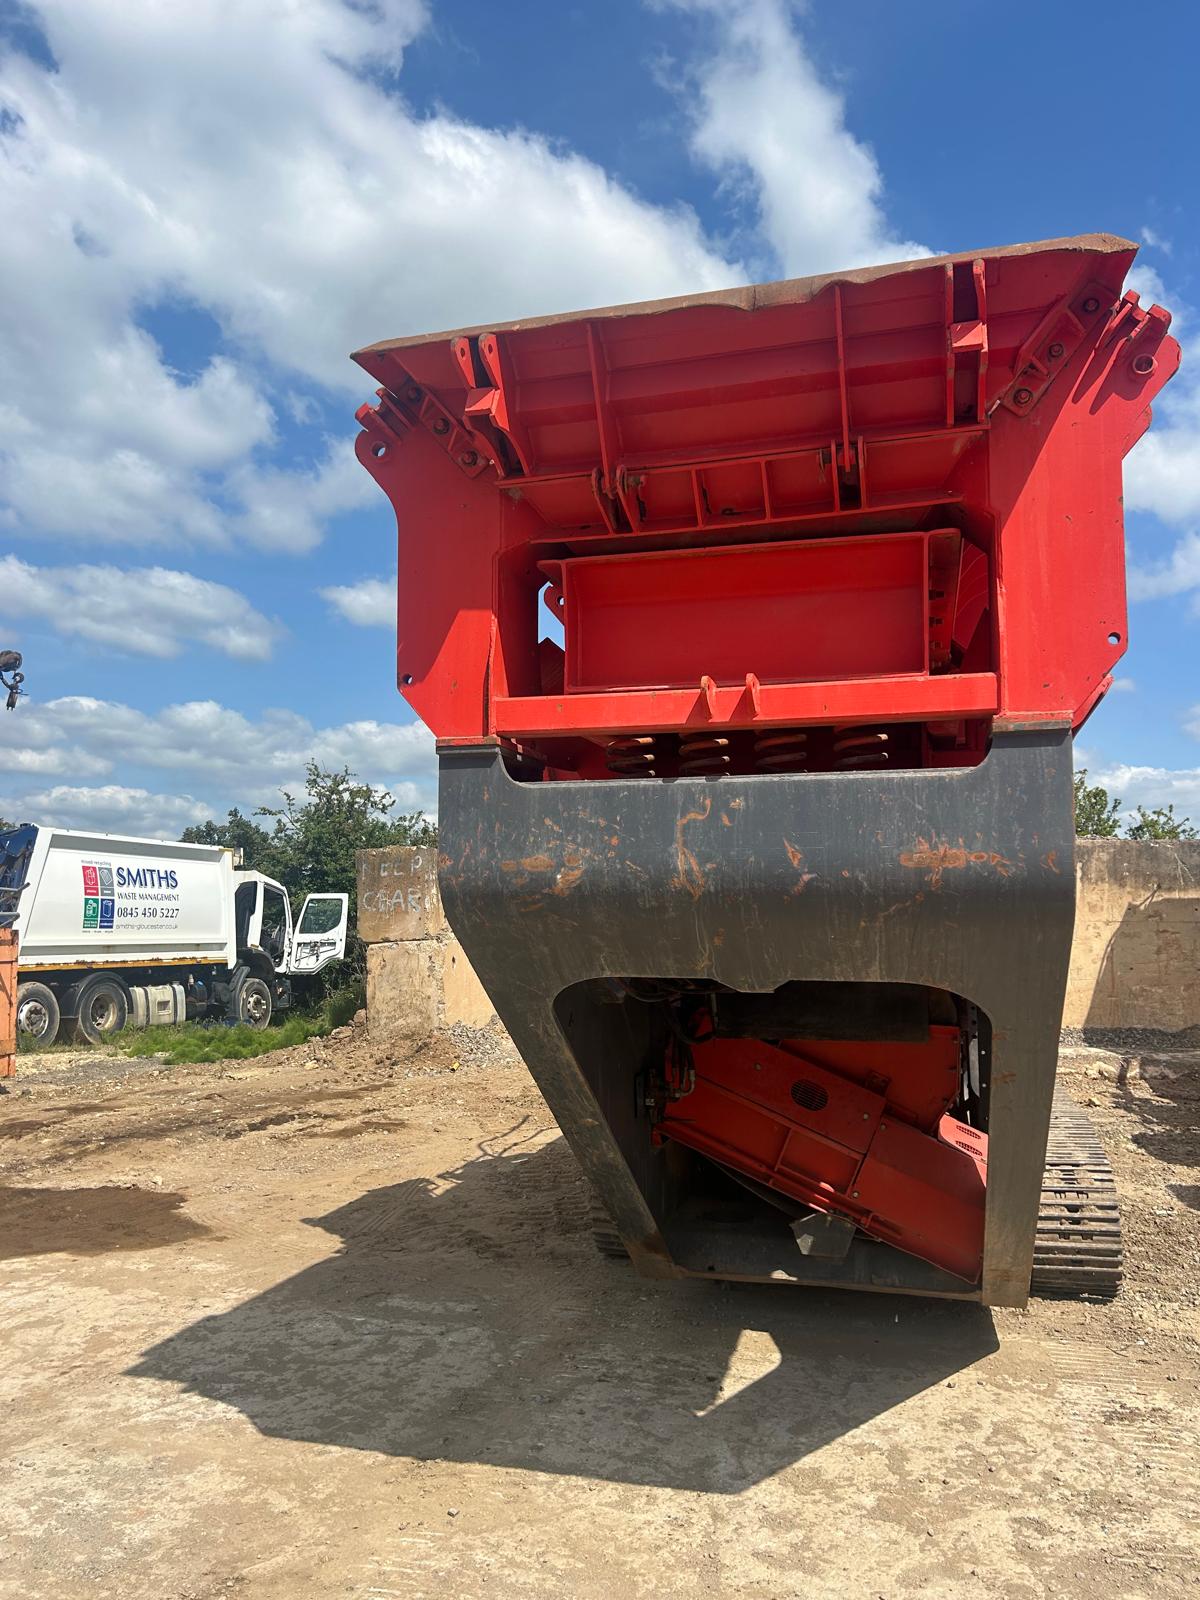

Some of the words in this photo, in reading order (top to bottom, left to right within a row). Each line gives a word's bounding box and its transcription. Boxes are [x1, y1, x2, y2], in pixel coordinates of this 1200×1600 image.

[116, 867, 178, 888] SMITHS
[139, 893, 179, 901] MANAGEMENT
[117, 907, 138, 918] 0845
[141, 907, 157, 918] 450
[160, 908, 180, 918] 5227
